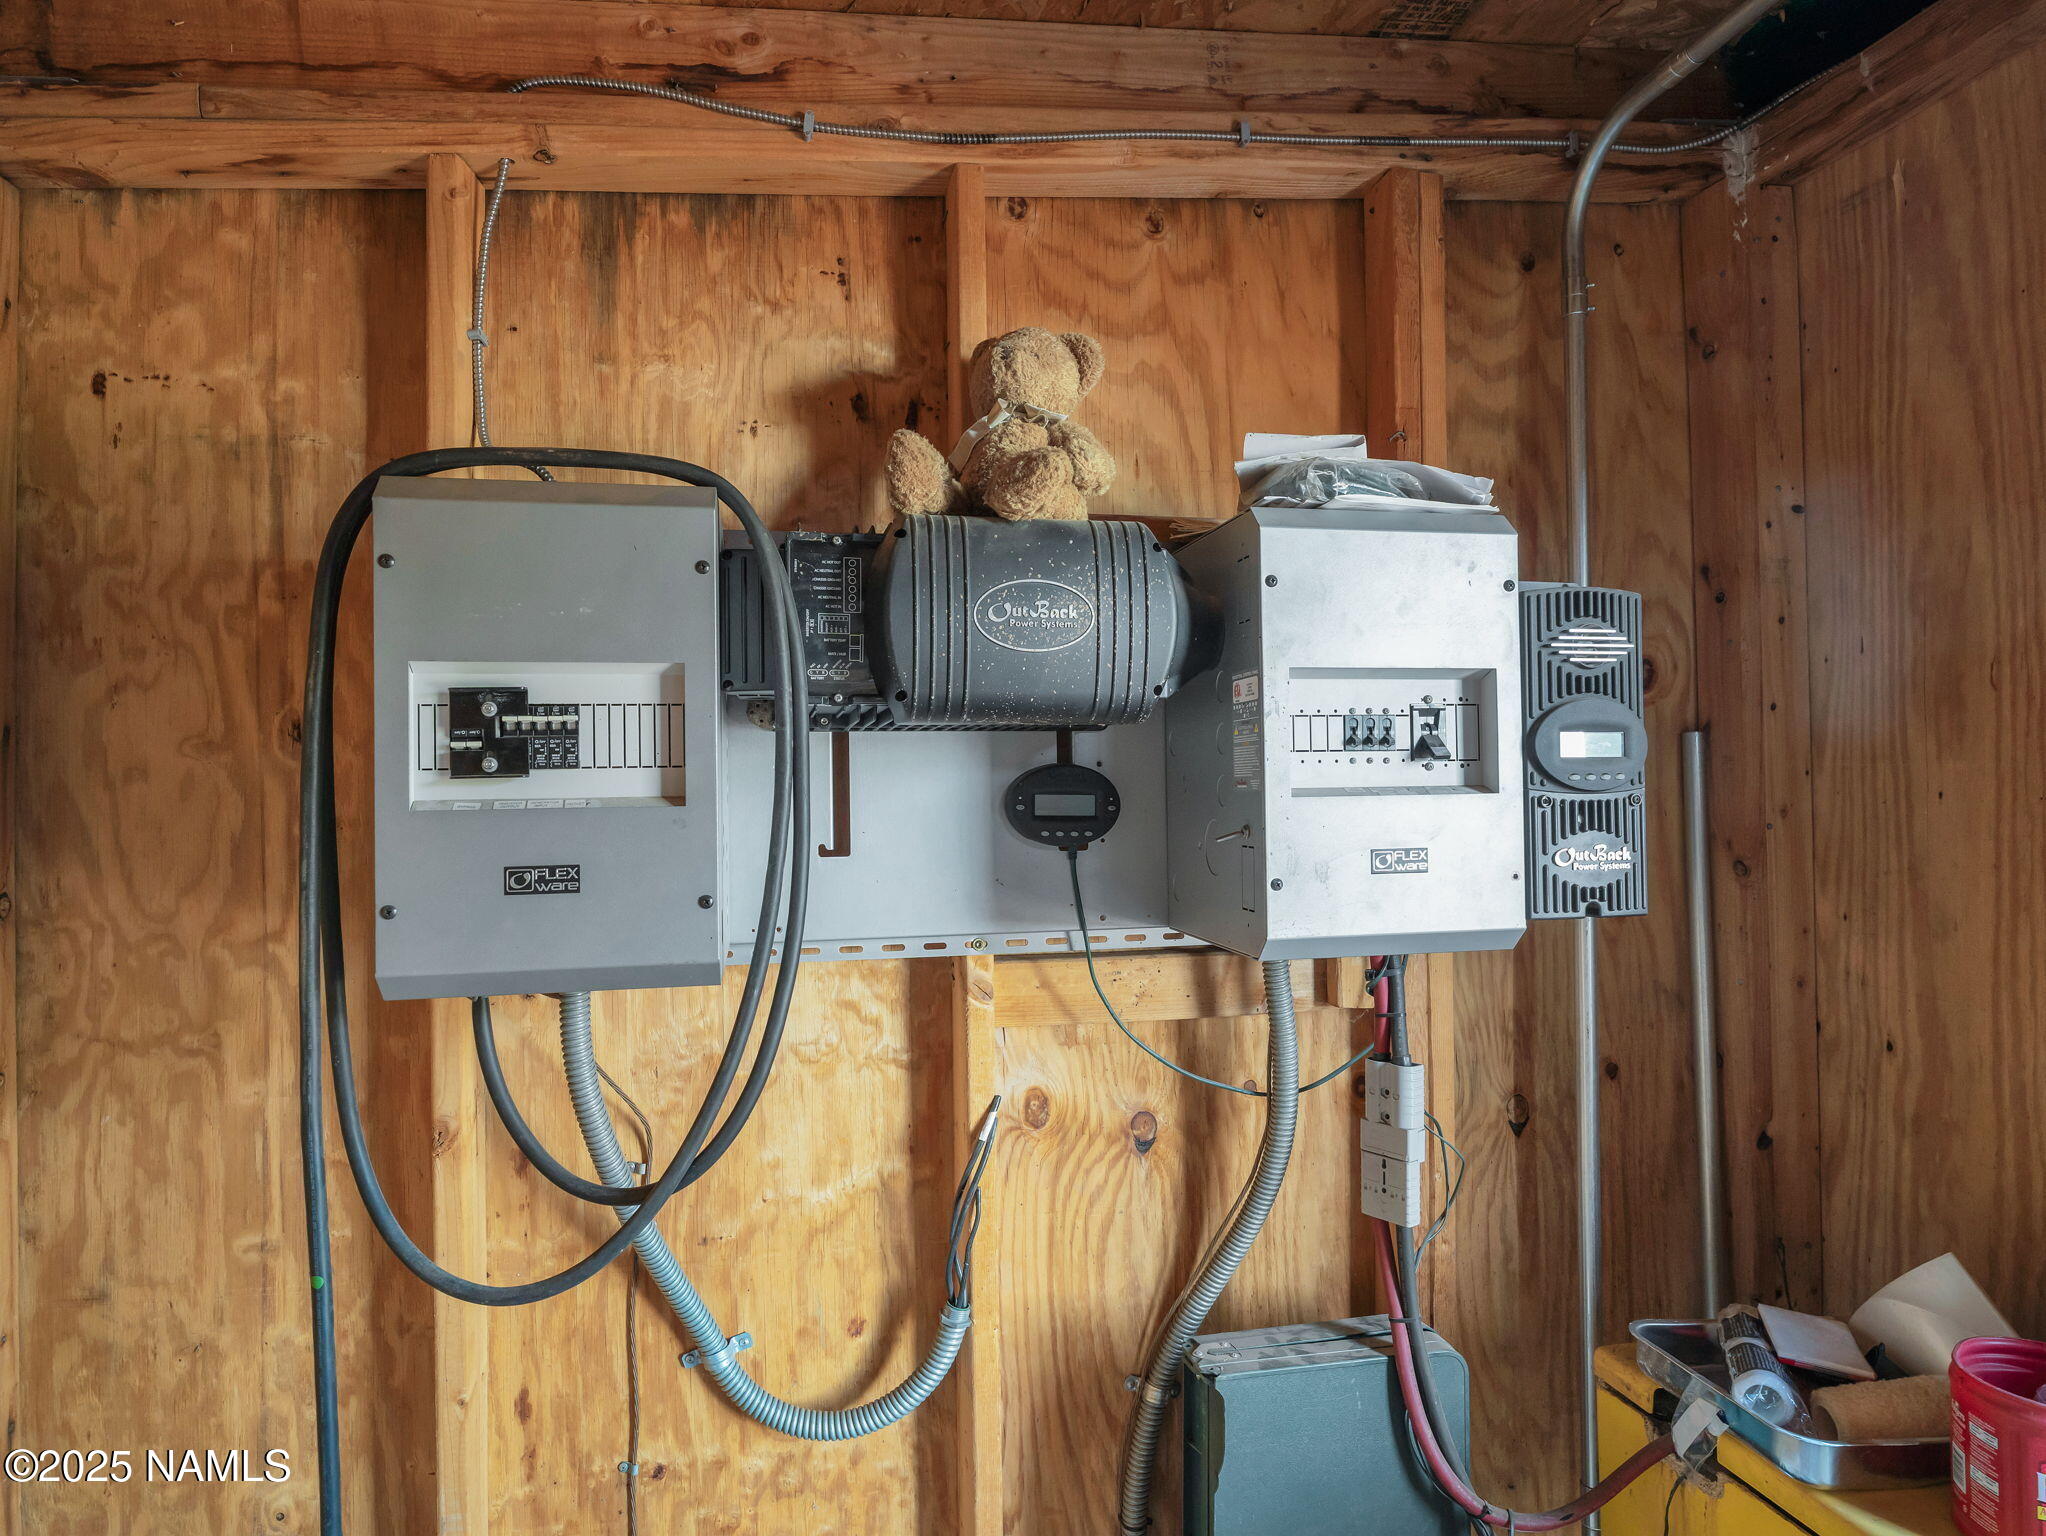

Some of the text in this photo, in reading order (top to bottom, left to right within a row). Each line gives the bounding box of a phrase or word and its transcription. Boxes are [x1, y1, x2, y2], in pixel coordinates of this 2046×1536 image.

[987, 600, 1079, 622] OutBack
[1009, 619, 1078, 629] Power Systems
[1394, 850, 1428, 861] FLEX
[1554, 843, 1632, 868] OutBack
[1394, 861, 1428, 871] ware
[1573, 861, 1631, 872] Power Systems
[534, 867, 579, 880] FLEX
[534, 881, 580, 892] ware
